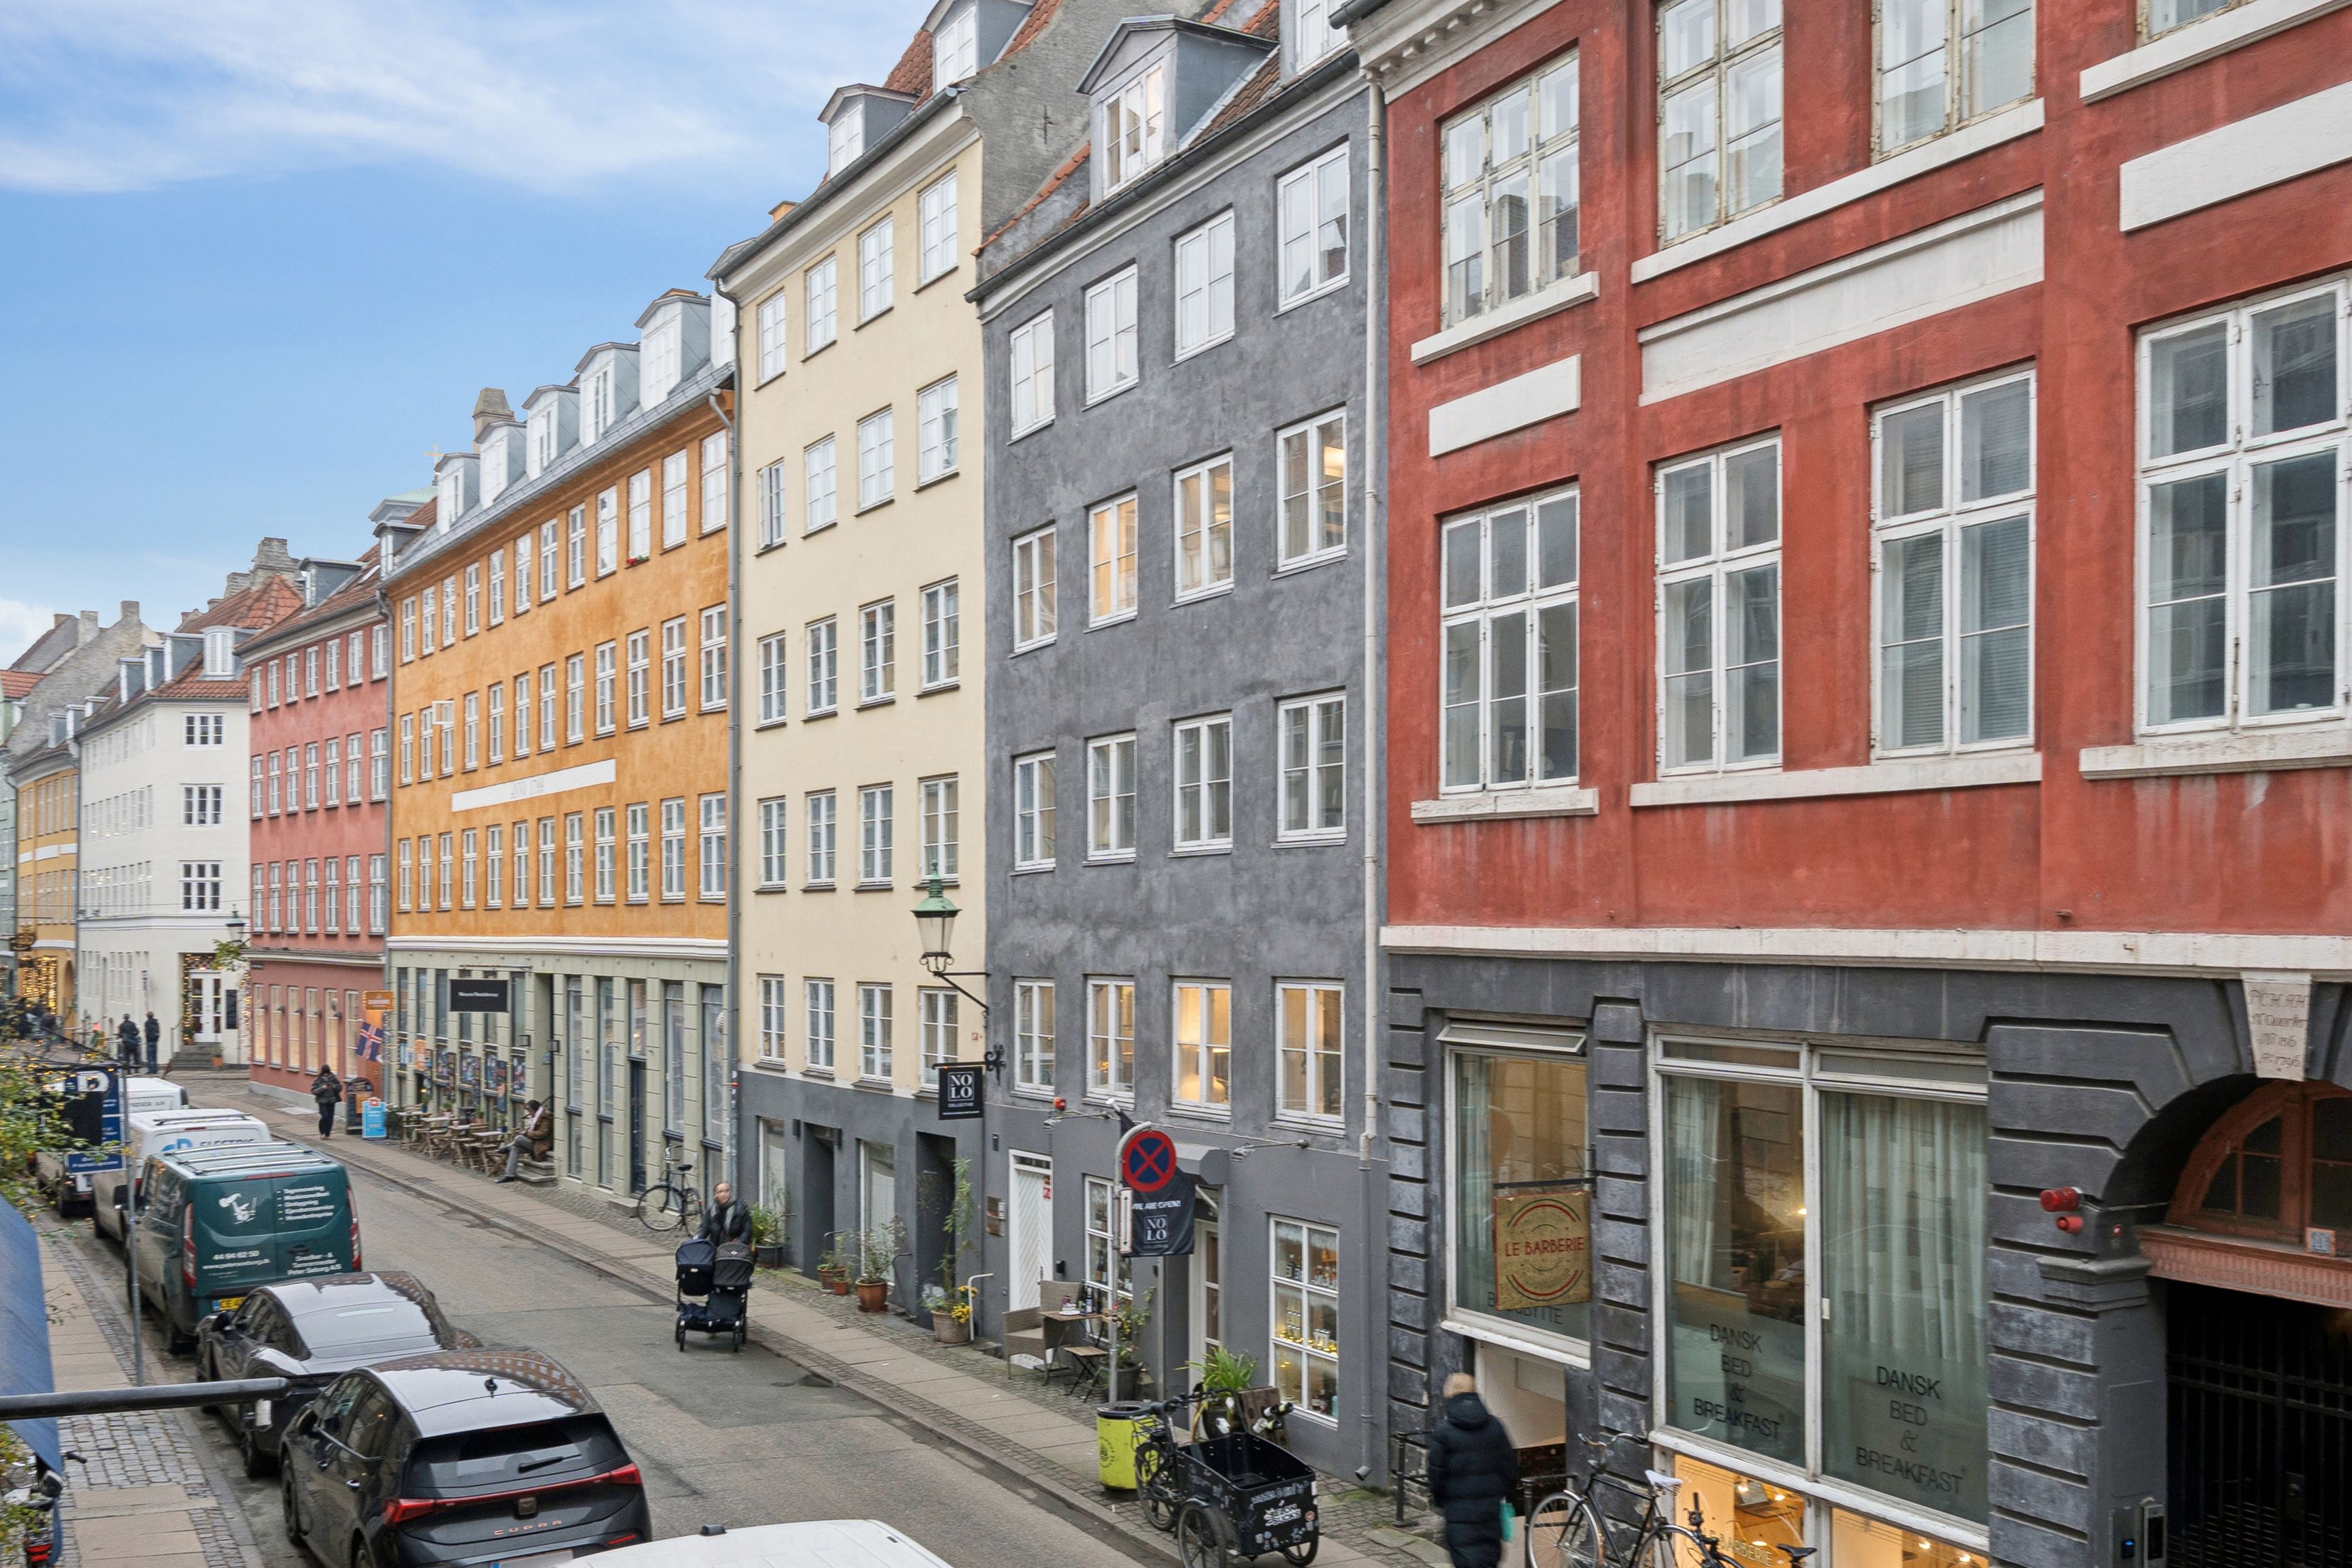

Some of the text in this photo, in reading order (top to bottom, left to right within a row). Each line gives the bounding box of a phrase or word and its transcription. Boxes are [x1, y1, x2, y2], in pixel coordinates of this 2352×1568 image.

[951, 1074, 973, 1086] NO
[951, 1086, 973, 1098] LO
[1147, 1218, 1166, 1229] NO
[1147, 1229, 1167, 1241] LO
[1505, 1237, 1584, 1256] LE BARBERIE
[1710, 1323, 1763, 1353] DANSK
[1721, 1354, 1752, 1377] BED
[1877, 1365, 1942, 1400] DANSK
[1731, 1383, 1744, 1403] &
[1889, 1399, 1928, 1426] BED
[1900, 1430, 1918, 1452] &
[494, 1520, 562, 1535] CUPRA
